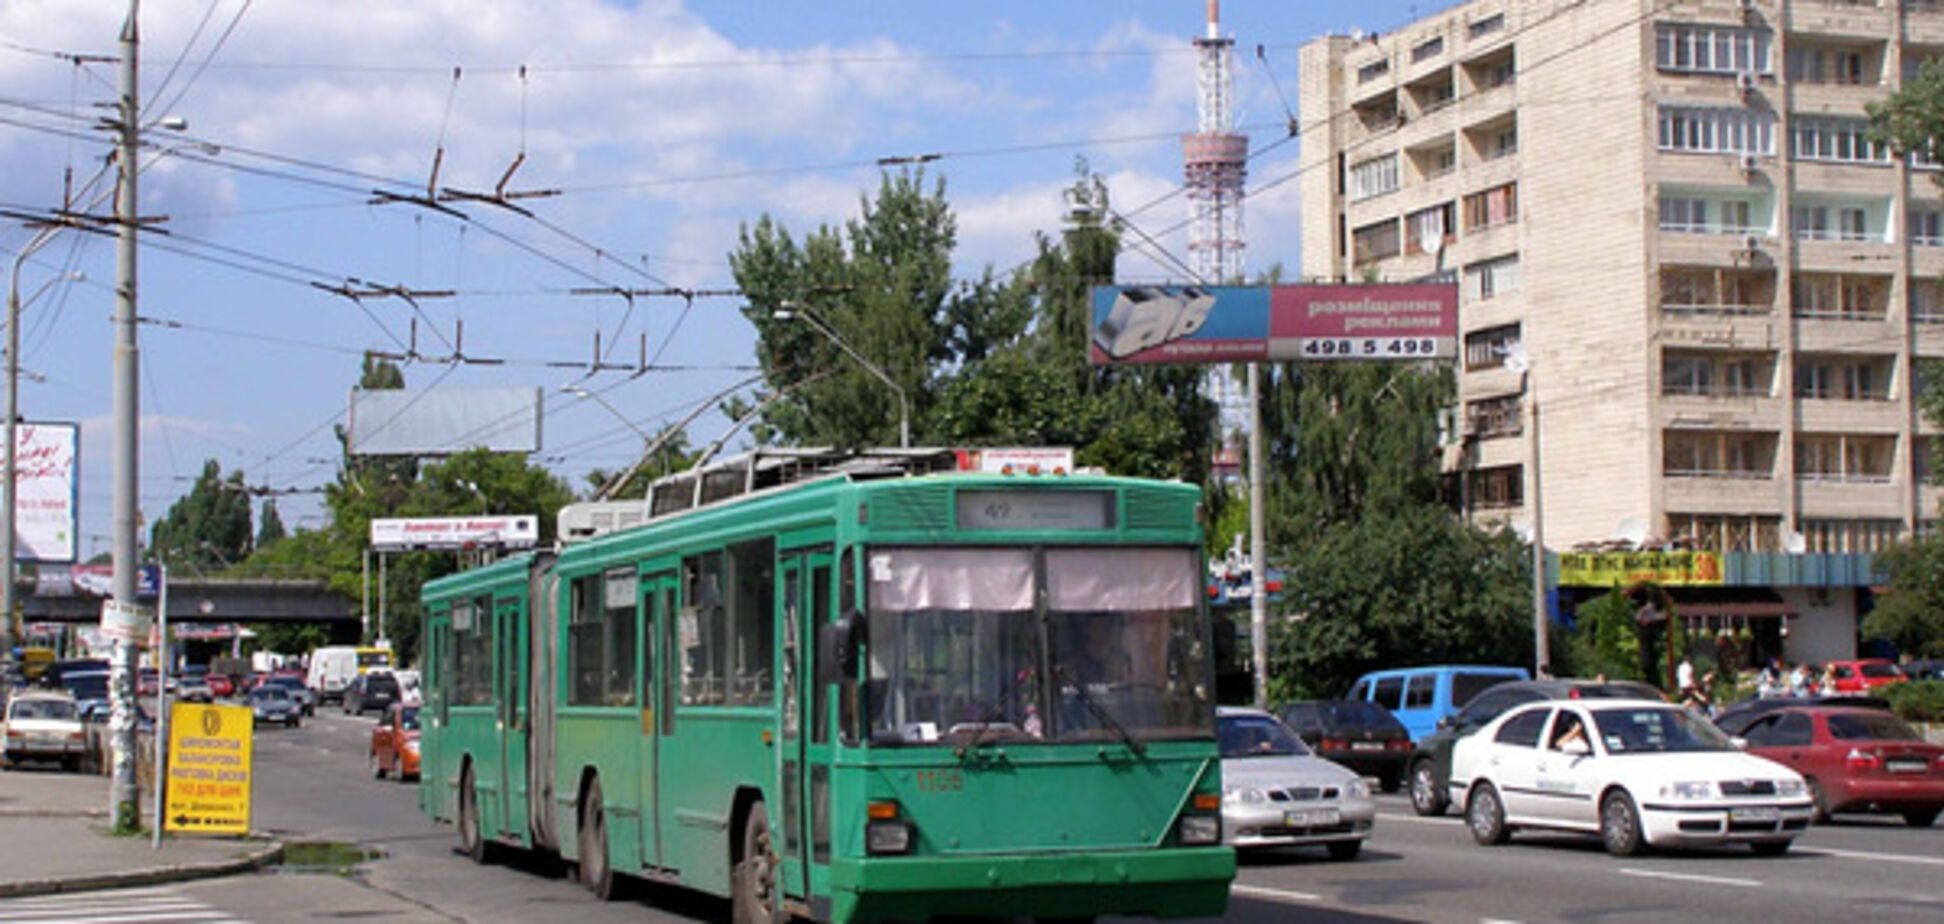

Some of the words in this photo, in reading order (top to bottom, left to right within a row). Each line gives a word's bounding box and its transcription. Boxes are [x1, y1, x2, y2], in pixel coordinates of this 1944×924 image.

[1308, 298, 1442, 318] розміщення
[1344, 315, 1442, 332] реклами
[1305, 339, 1350, 354] 498
[1363, 339, 1376, 354] 5
[1387, 339, 1434, 354] 498
